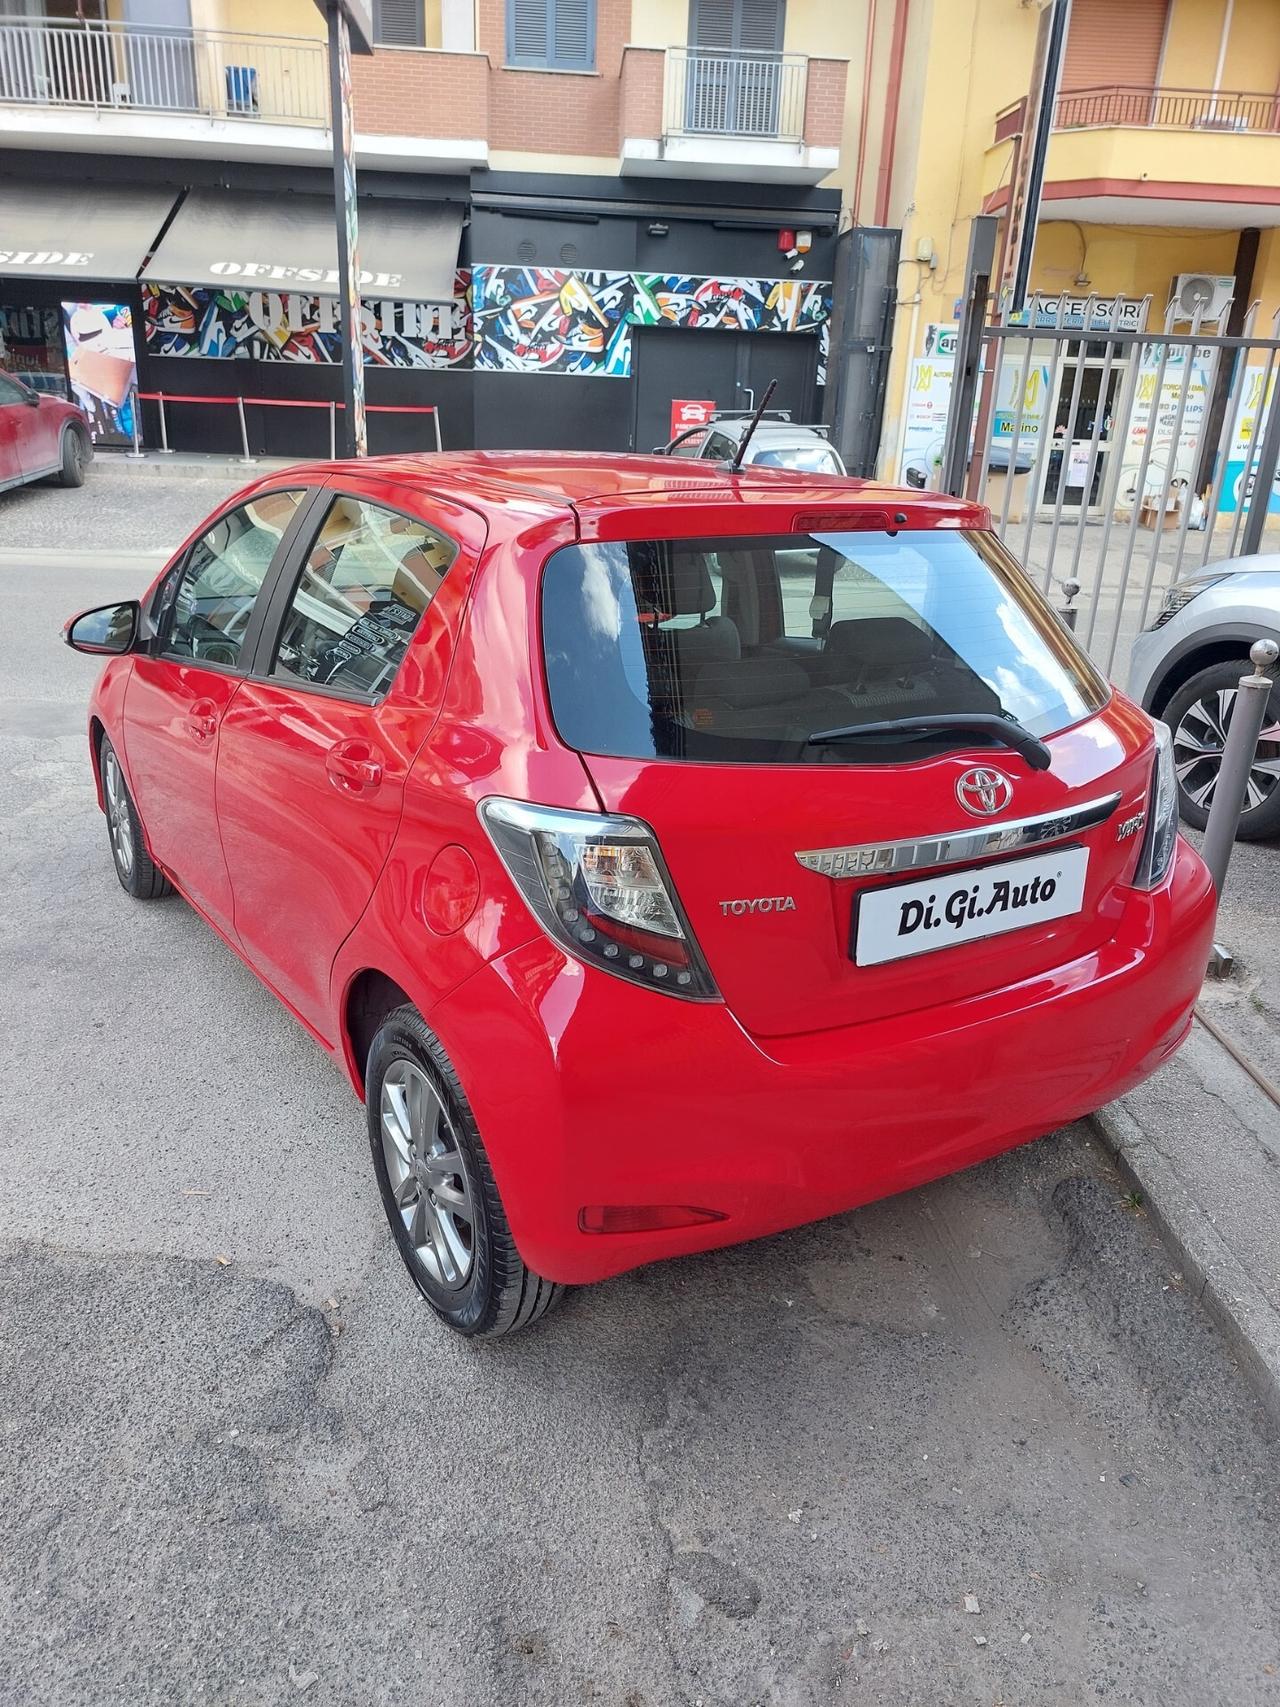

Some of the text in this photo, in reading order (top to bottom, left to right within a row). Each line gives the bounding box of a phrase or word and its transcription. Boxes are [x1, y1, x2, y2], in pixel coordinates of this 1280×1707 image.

[1171, 404, 1203, 412] PLIPS
[1001, 421, 1038, 432] Maino
[719, 896, 797, 916] TOYOTA
